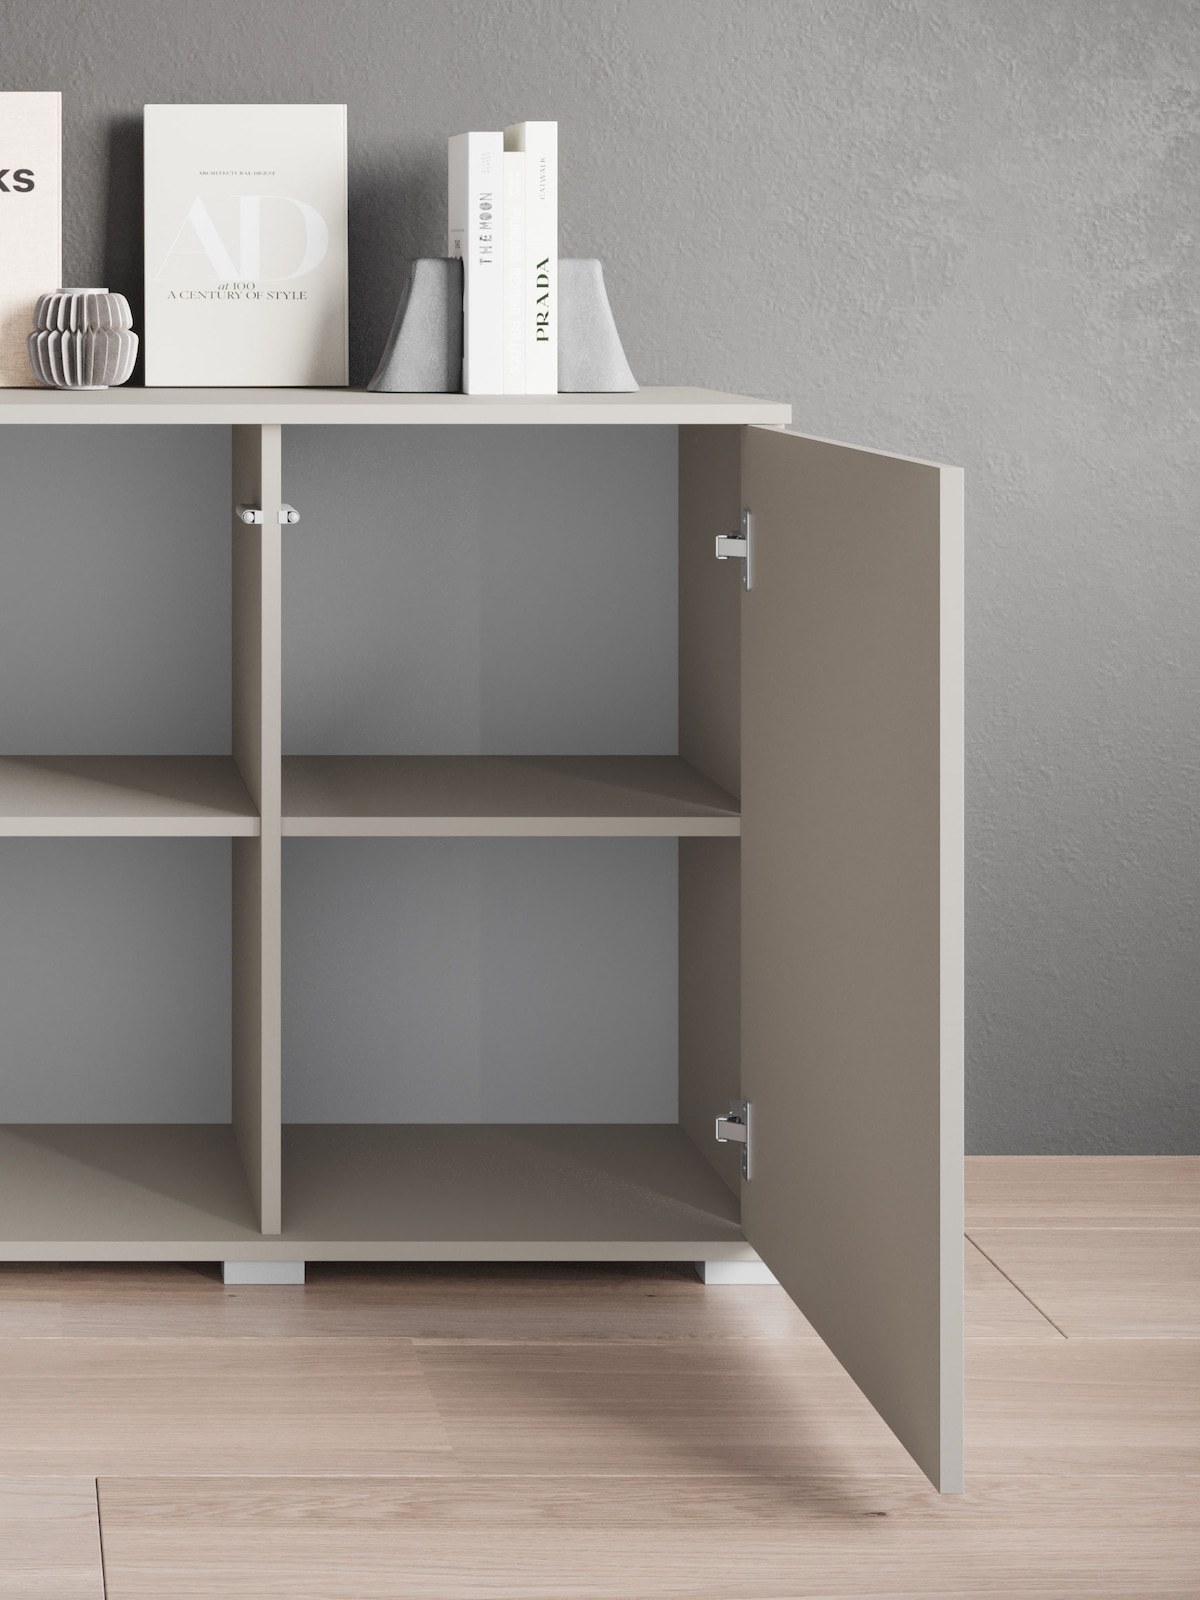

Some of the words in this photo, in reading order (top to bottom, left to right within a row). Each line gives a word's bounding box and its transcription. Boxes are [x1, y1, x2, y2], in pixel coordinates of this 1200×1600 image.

[539, 157, 547, 200] CATWALK
[479, 193, 493, 229] MOON
[153, 194, 329, 281] AD
[479, 235, 493, 265] THE
[167, 291, 176, 299] A
[179, 291, 243, 299] CENTURY
[246, 291, 263, 300] OF
[266, 291, 308, 300] STYLE
[536, 257, 550, 342] PRADA
